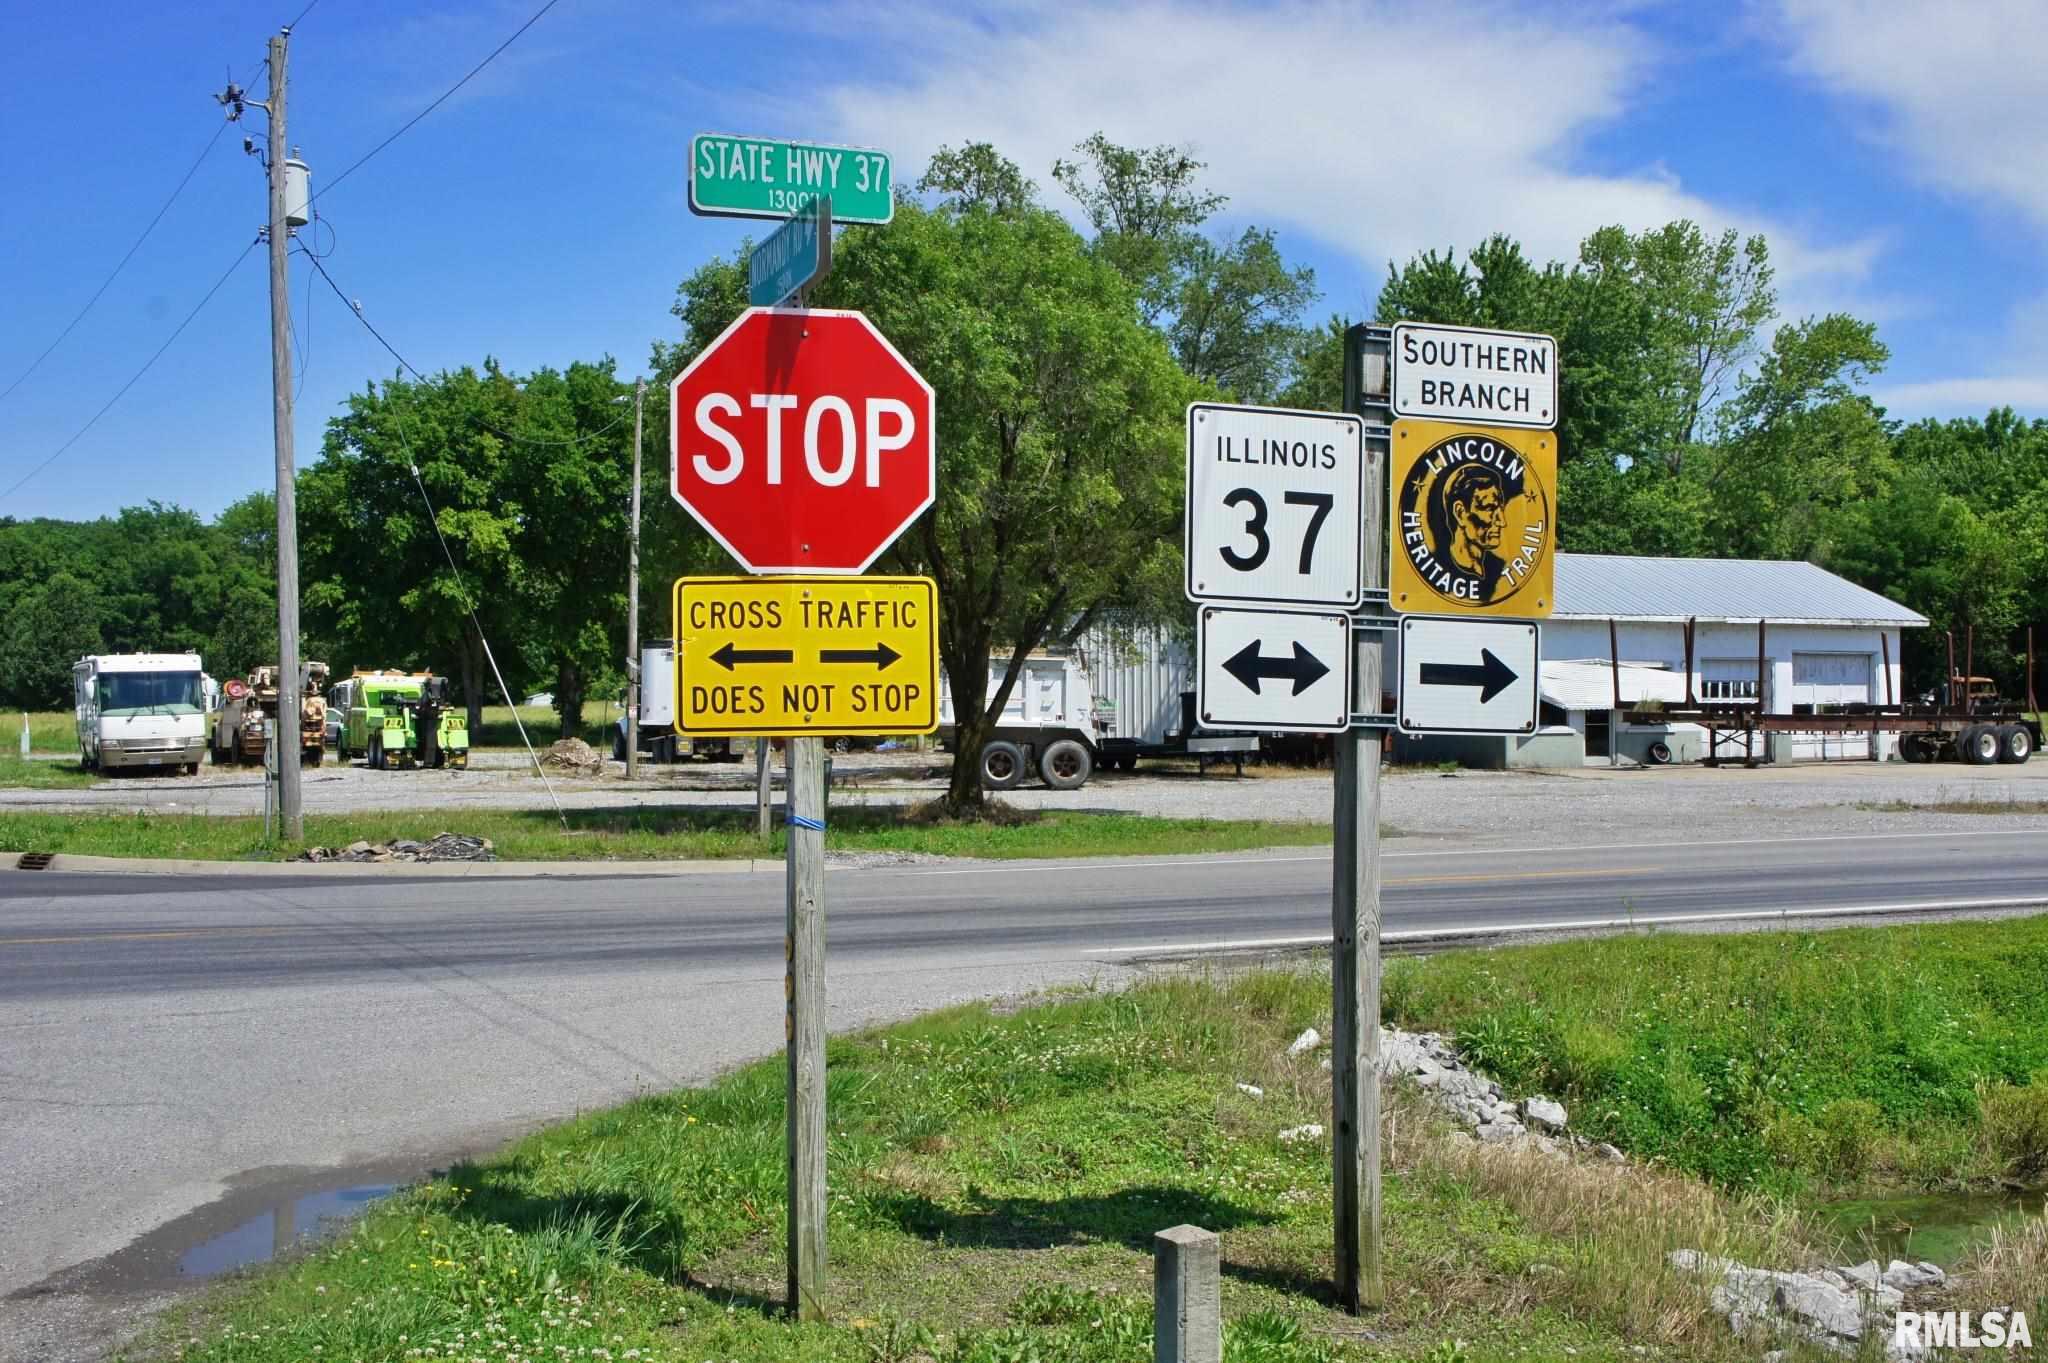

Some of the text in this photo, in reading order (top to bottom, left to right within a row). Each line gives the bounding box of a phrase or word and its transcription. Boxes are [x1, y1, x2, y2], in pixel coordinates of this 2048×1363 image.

[700, 140, 885, 192] STATE HWY 37
[1404, 338, 1546, 374] SOUTHERN
[1421, 380, 1529, 412] BRANCH
[692, 392, 916, 488] STOP
[1217, 436, 1336, 469] ILLINOIS
[1425, 439, 1525, 481] LINCOLN
[1219, 487, 1334, 575] 37
[1403, 511, 1480, 599] HERITAGE
[1501, 519, 1544, 586] TRAIL
[690, 600, 917, 629] CROSS TRAFFIC
[692, 684, 920, 714] DOES NOT STOP
